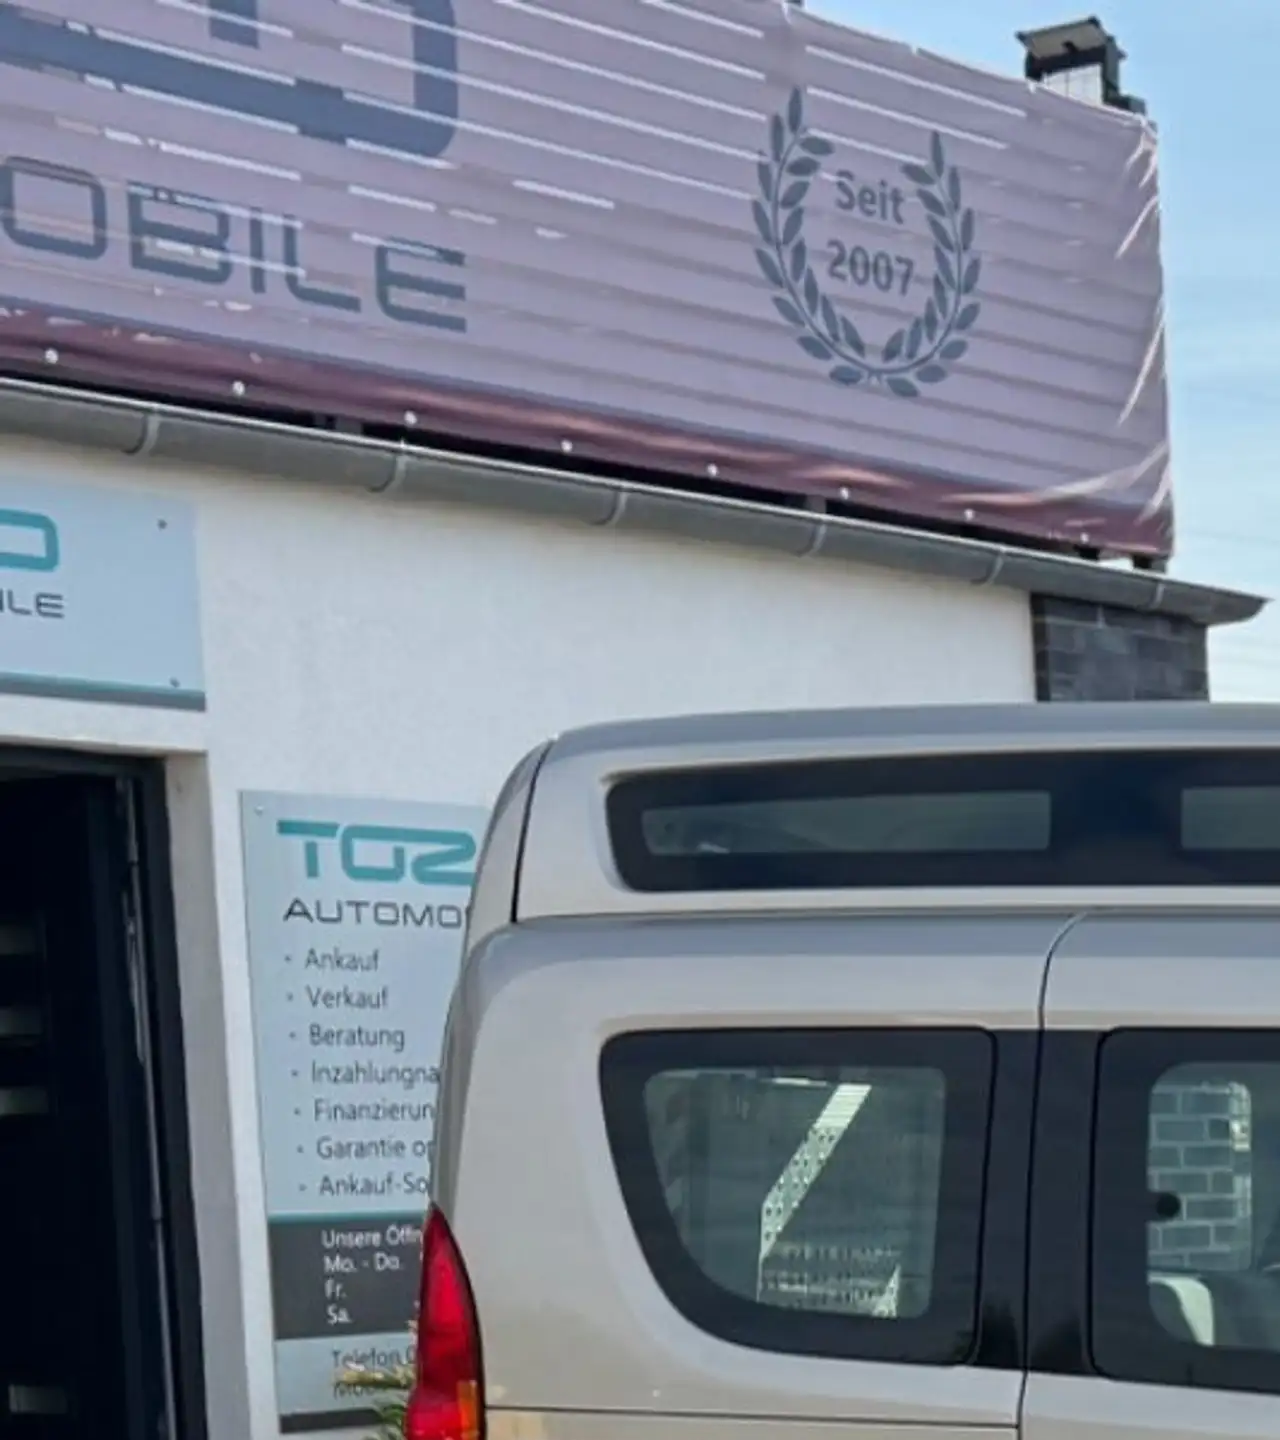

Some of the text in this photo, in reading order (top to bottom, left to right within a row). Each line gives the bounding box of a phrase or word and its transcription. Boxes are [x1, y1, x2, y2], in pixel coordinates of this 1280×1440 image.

[834, 171, 905, 225] Seit
[827, 239, 914, 297] 2007
[282, 898, 463, 929] AUTOMO
[304, 948, 381, 971] Ankauf
[305, 985, 390, 1010] Verkauf
[309, 1024, 406, 1053] Beratung
[316, 1135, 406, 1160] Garantie
[321, 1229, 382, 1249] Unsere
[324, 1277, 348, 1299] Fr.
[327, 1303, 353, 1325] Sa.
